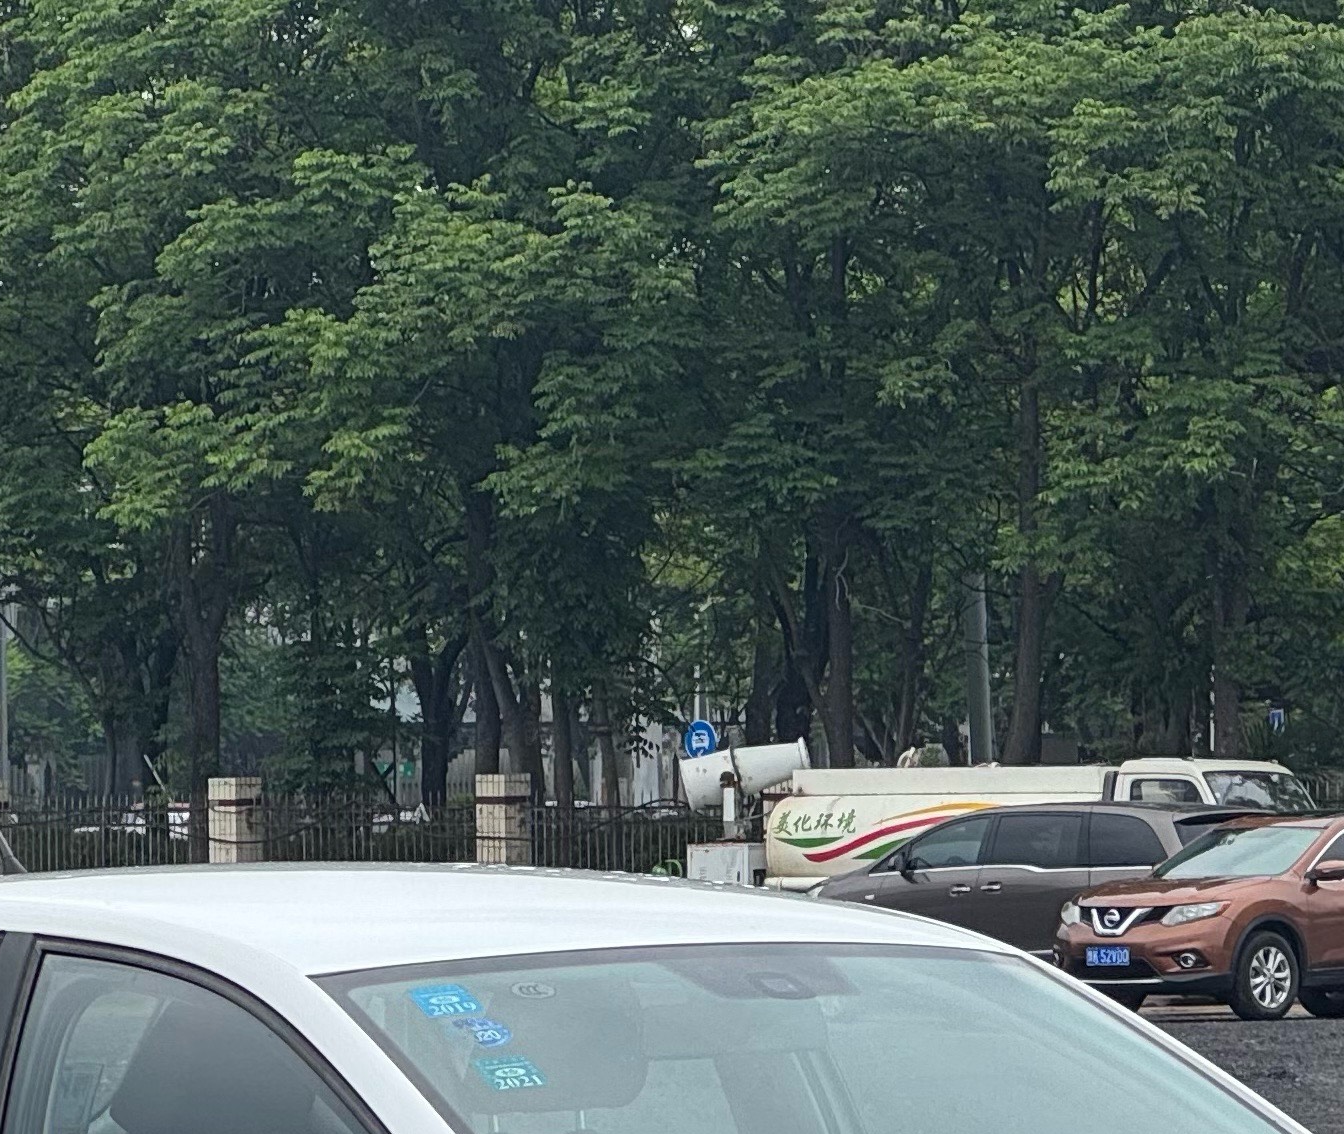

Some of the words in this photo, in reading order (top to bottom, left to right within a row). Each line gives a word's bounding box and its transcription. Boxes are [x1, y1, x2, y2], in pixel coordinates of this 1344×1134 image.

[772, 808, 857, 836] 美化环境
[429, 1001, 477, 1016] 2019
[494, 1074, 543, 1090] 2021
